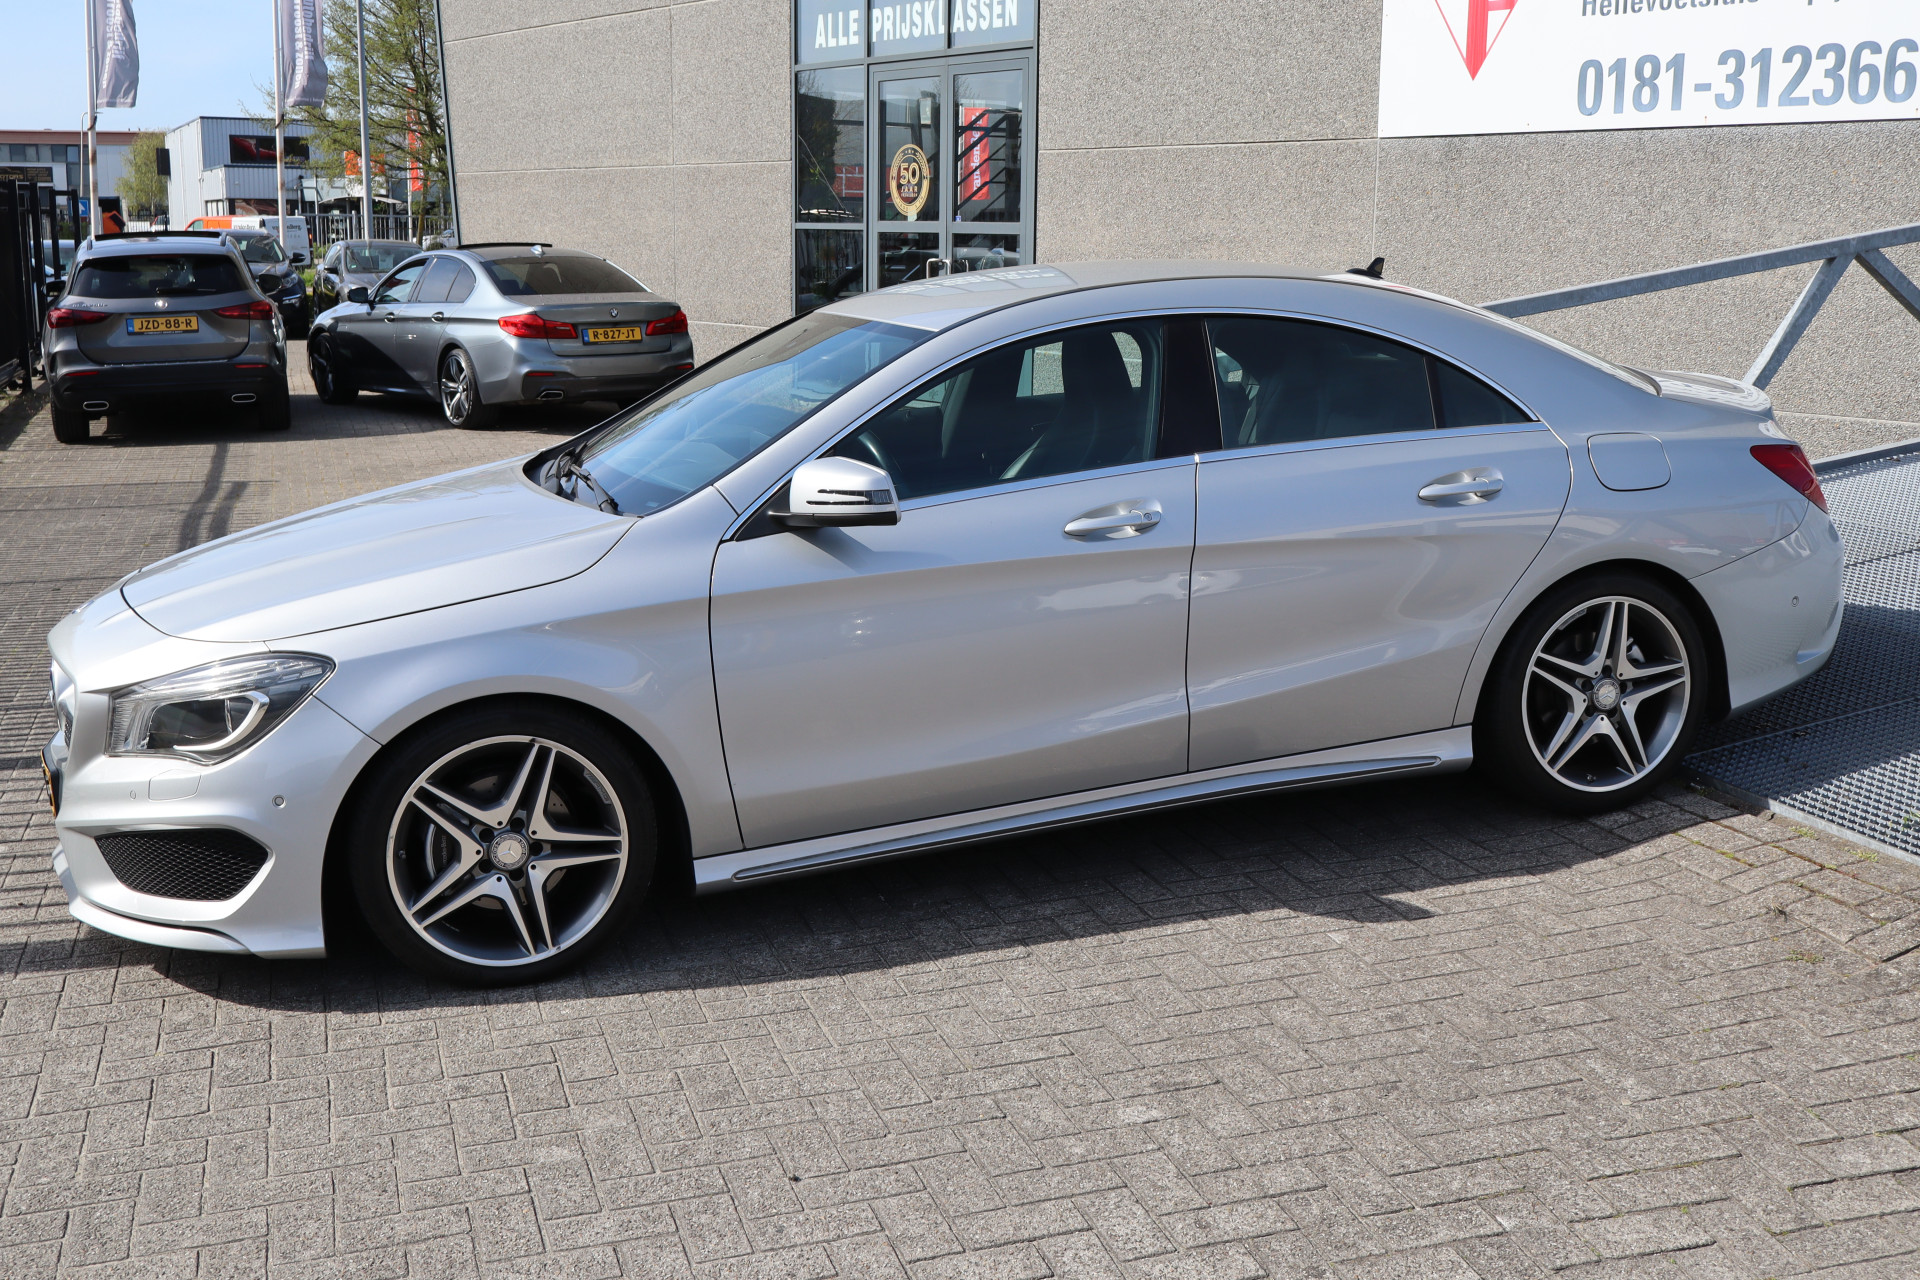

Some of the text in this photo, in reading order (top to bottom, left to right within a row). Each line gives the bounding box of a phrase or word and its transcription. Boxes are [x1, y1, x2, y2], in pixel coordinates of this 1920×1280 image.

[815, 0, 1018, 49] ALLE PRIJSKLASSEN
[1577, 38, 1919, 116] 0181-312366
[900, 162, 920, 185] 50
[901, 185, 918, 193] JAAR
[138, 318, 192, 331] JZD-88-R
[592, 328, 636, 340] R-827-JT
